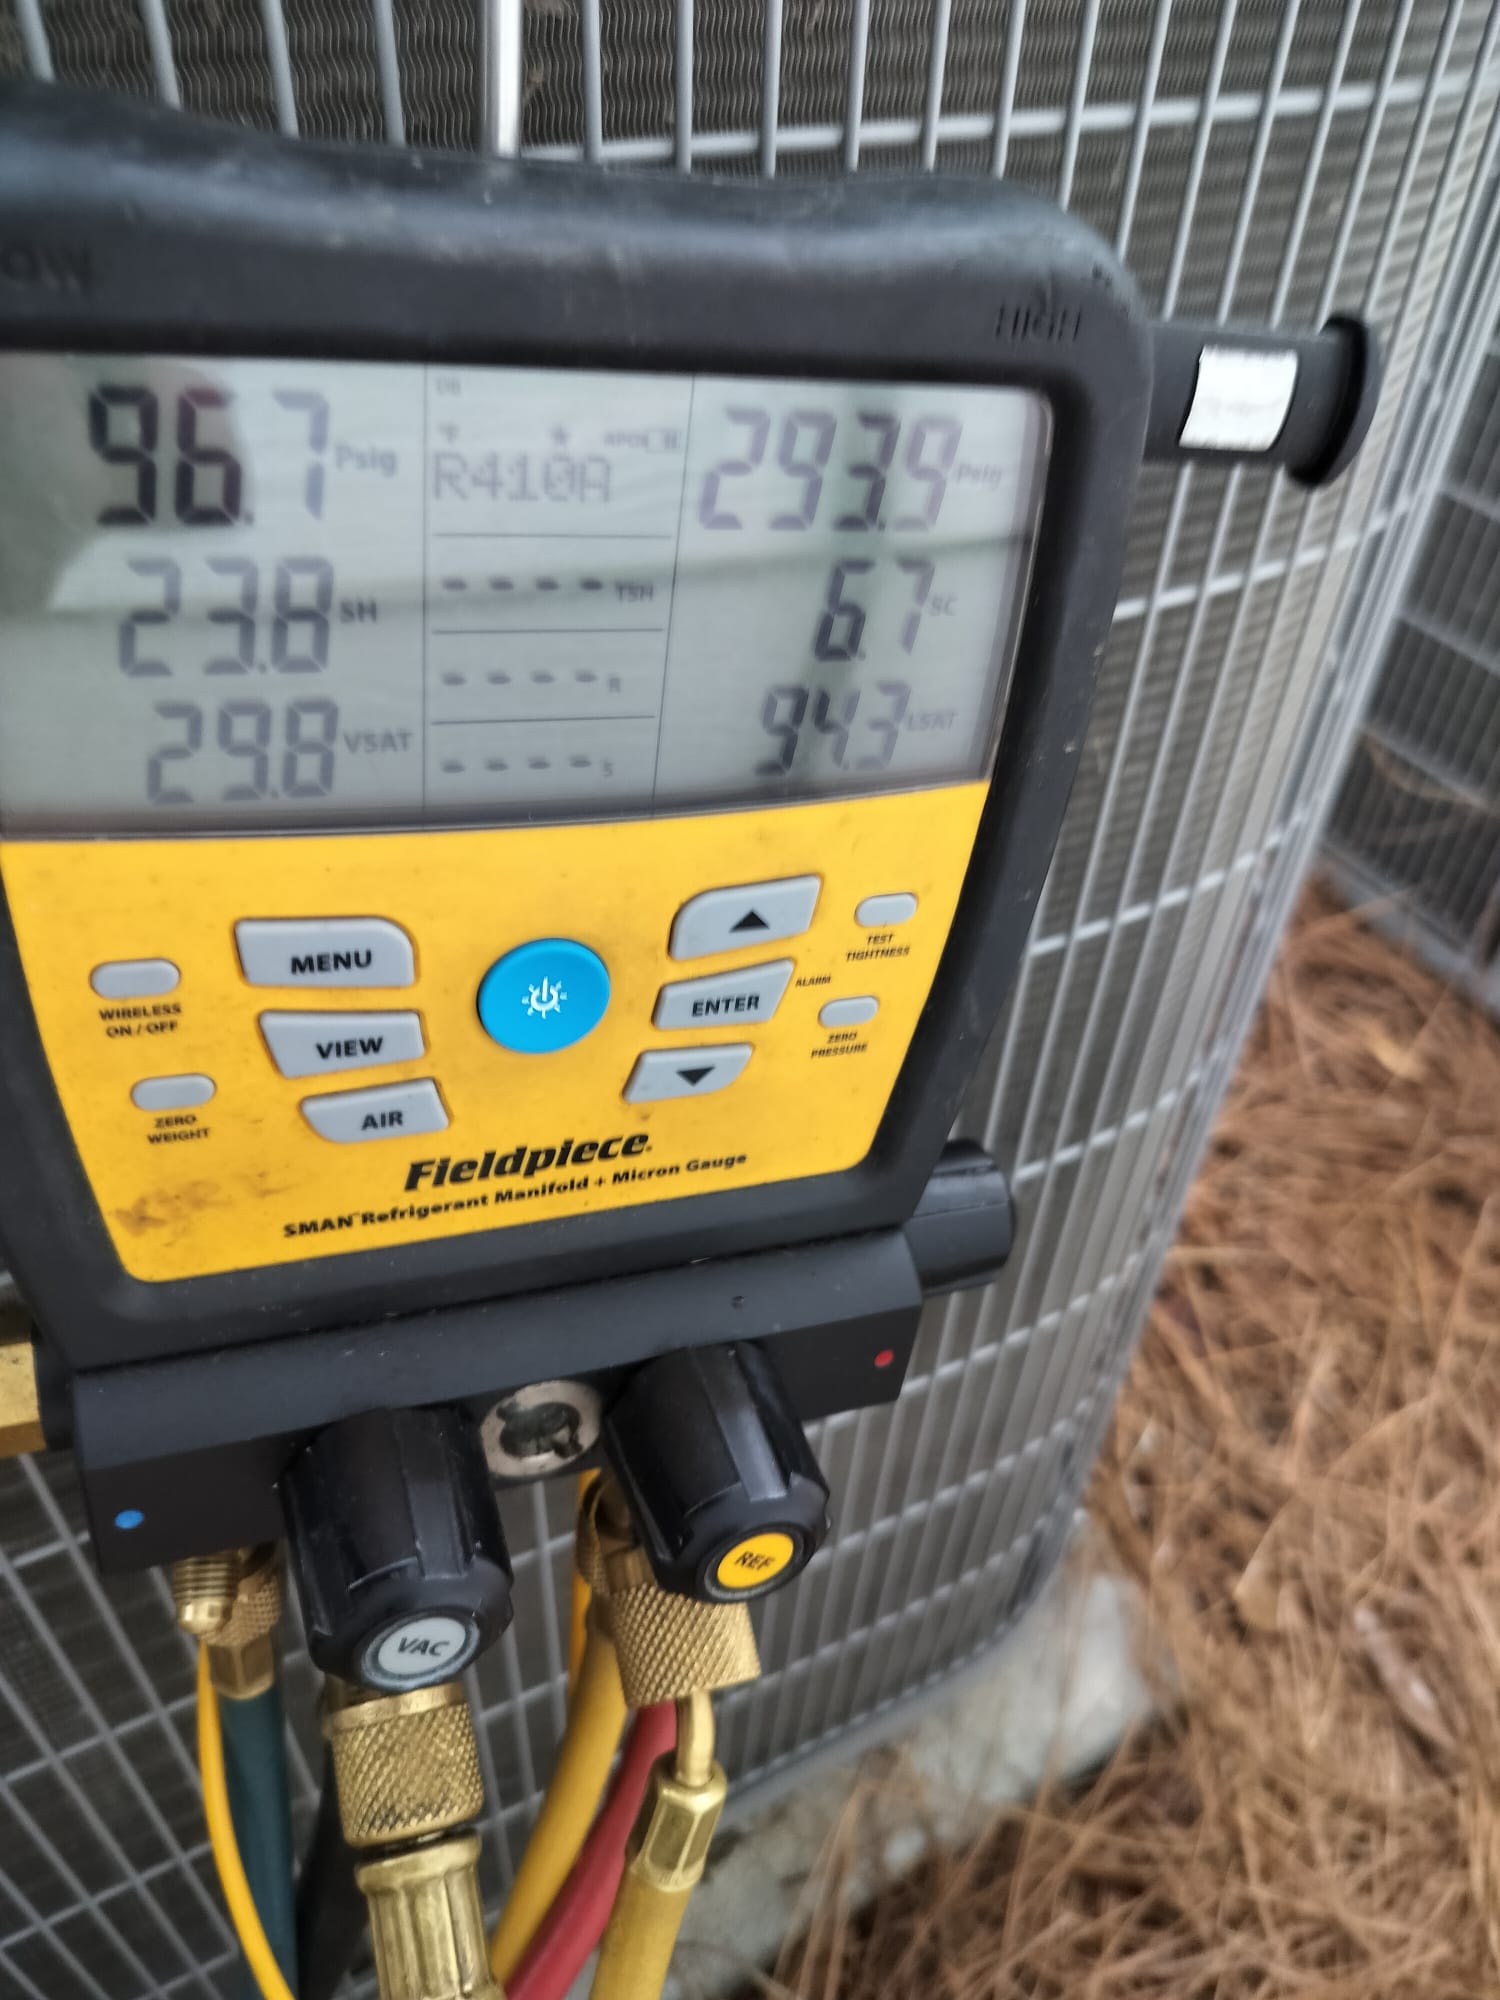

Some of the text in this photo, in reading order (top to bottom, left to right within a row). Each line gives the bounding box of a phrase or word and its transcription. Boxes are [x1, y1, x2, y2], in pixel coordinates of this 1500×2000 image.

[88, 384, 331, 527] 96.7
[433, 450, 612, 502] R410A
[118, 556, 377, 677] 23.8 SH
[146, 698, 412, 805] 29.8 VSAT
[866, 933, 895, 945] TEST
[290, 949, 373, 976] MENU
[846, 945, 911, 961] TIGHTNESS
[795, 974, 832, 987] ALARM
[98, 1002, 182, 1021] WIRELESS
[691, 994, 761, 1018] ENTER
[315, 1036, 384, 1060] VIEW
[827, 1031, 858, 1043] ZERO
[811, 1042, 869, 1059] PRESSURE
[154, 1114, 198, 1129] ZERO
[360, 1110, 404, 1131] AIR
[147, 1127, 211, 1145] WEIGHT
[404, 1133, 649, 1192] Fieldpiece
[361, 1195, 489, 1225] Refrigerant
[495, 1176, 589, 1204] Manifold
[612, 1162, 681, 1185] Micron
[686, 1153, 748, 1172] Gauge
[733, 1550, 775, 1572] REF
[397, 1636, 450, 1658] VAC
